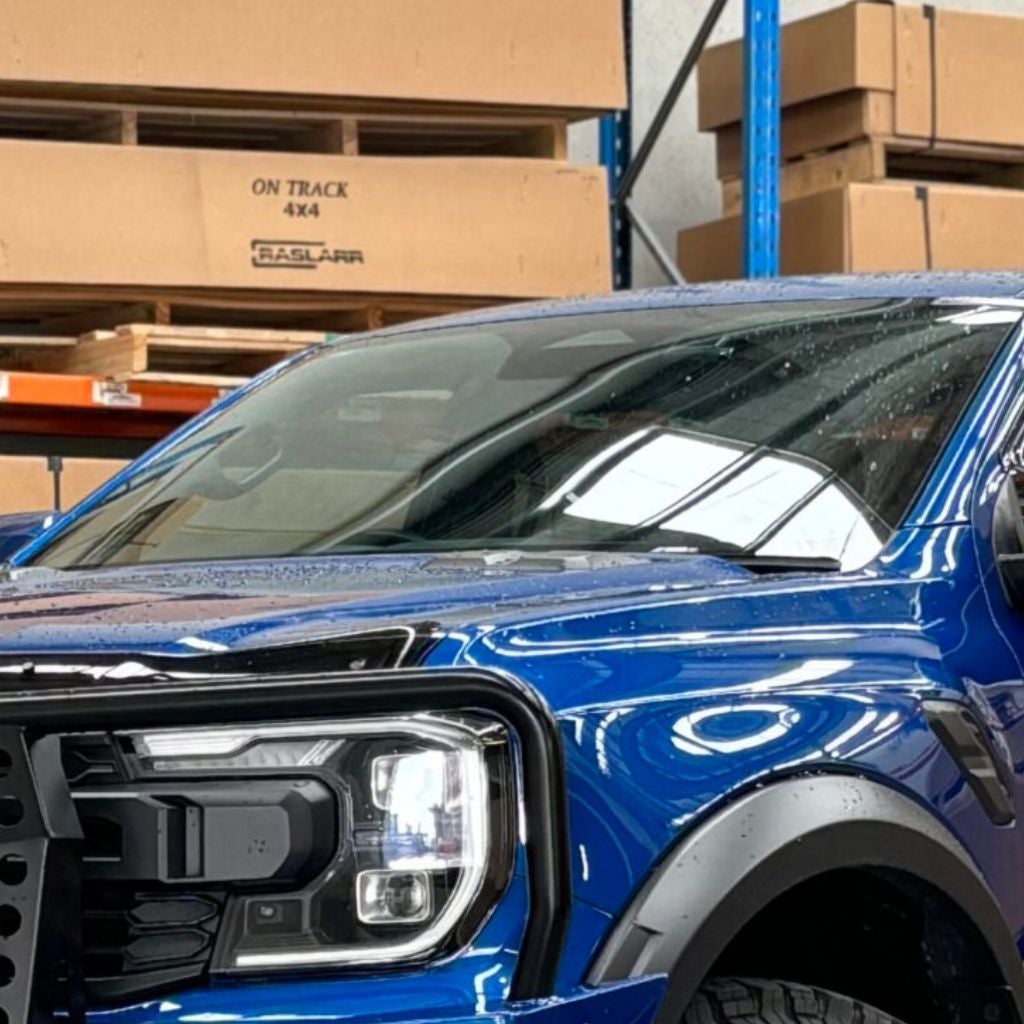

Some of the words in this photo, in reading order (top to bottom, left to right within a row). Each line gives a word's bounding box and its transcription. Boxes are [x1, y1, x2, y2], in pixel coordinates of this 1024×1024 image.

[251, 178, 281, 196] ON
[286, 180, 349, 198] TRACK
[258, 246, 365, 264] RASLARR
